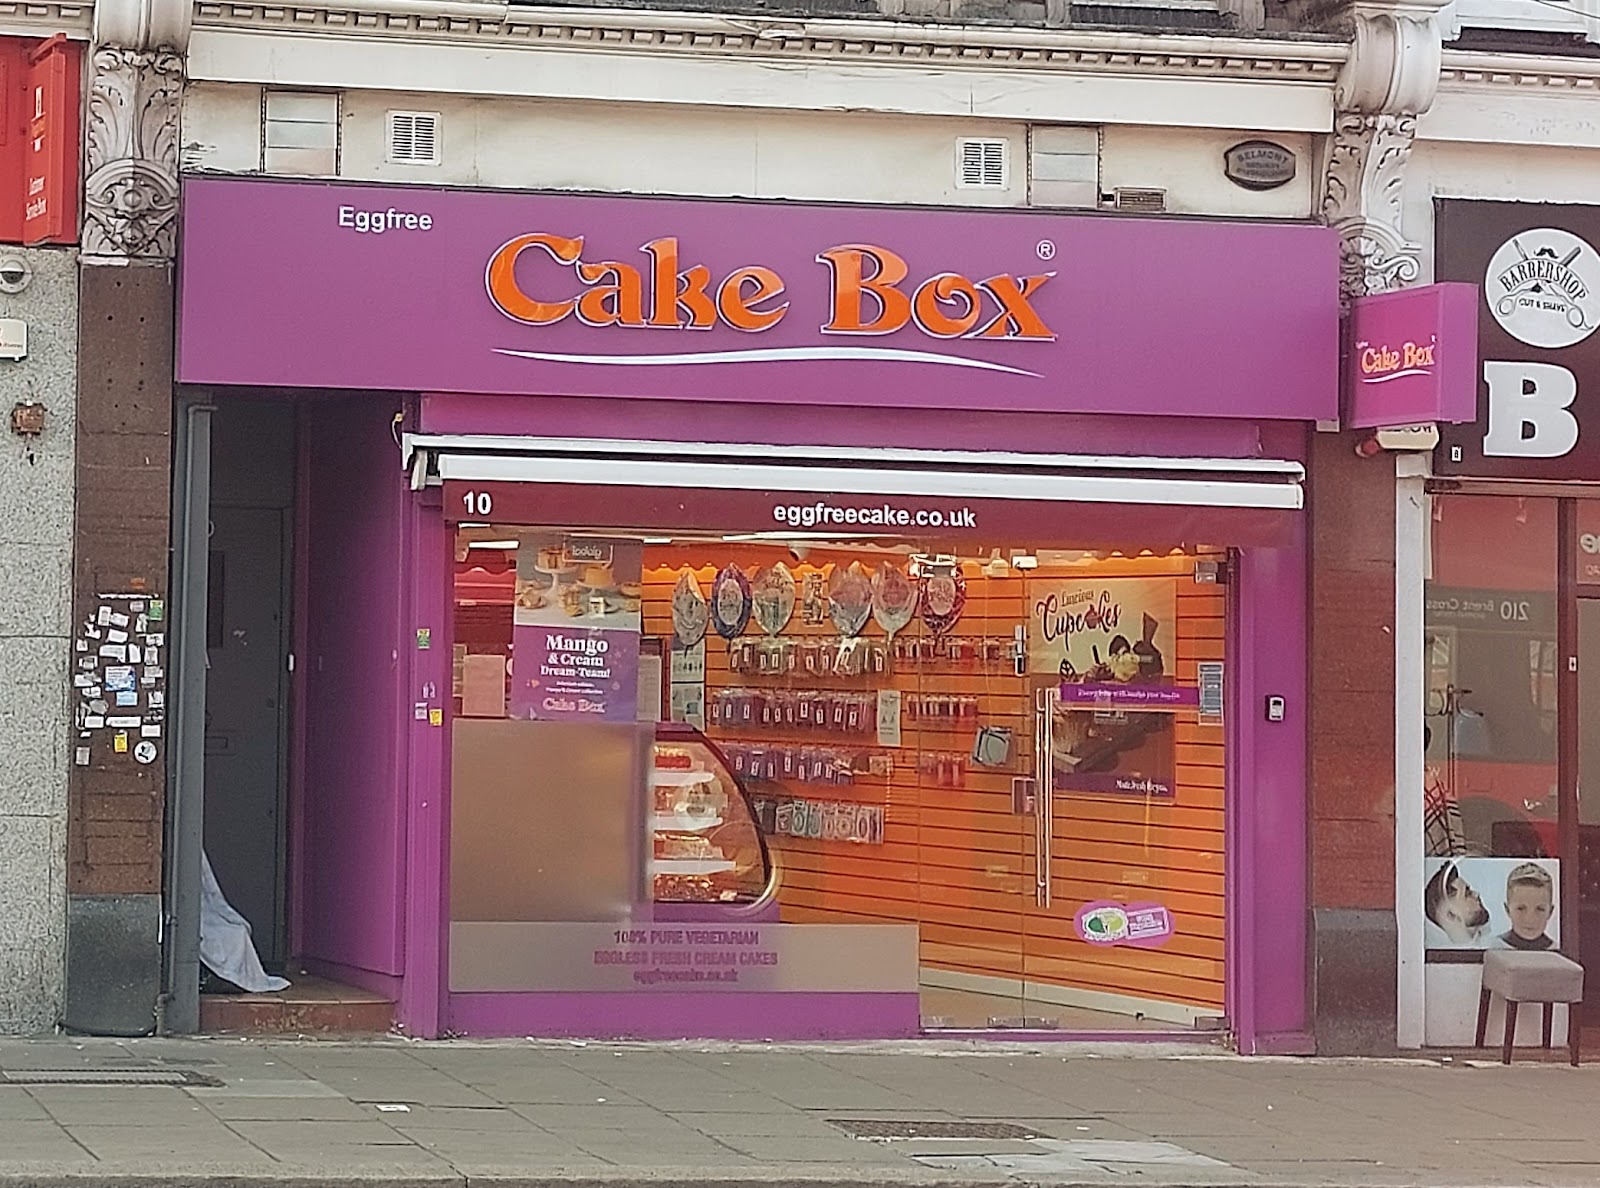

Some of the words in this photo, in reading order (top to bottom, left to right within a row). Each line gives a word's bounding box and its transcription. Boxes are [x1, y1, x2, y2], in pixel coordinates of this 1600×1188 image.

[338, 205, 433, 233] Eggfree
[485, 231, 790, 334] Cake
[814, 242, 1058, 343] Box
[1500, 260, 1586, 300] BARBERSHOP
[1519, 298, 1534, 307] CUT
[1361, 345, 1400, 373] Cake
[1403, 342, 1435, 369] Box
[1483, 360, 1579, 457] B
[463, 491, 492, 515] 10
[773, 504, 977, 529] eggfreecake.co.uk
[546, 634, 609, 656] Mango
[548, 652, 559, 665] &
[560, 653, 604, 667] Cream
[651, 930, 683, 945] PURE
[686, 931, 760, 945] VEGETARIAN
[652, 951, 691, 966] FRESH
[695, 951, 736, 966] CREAM
[740, 951, 778, 966] CAKES
